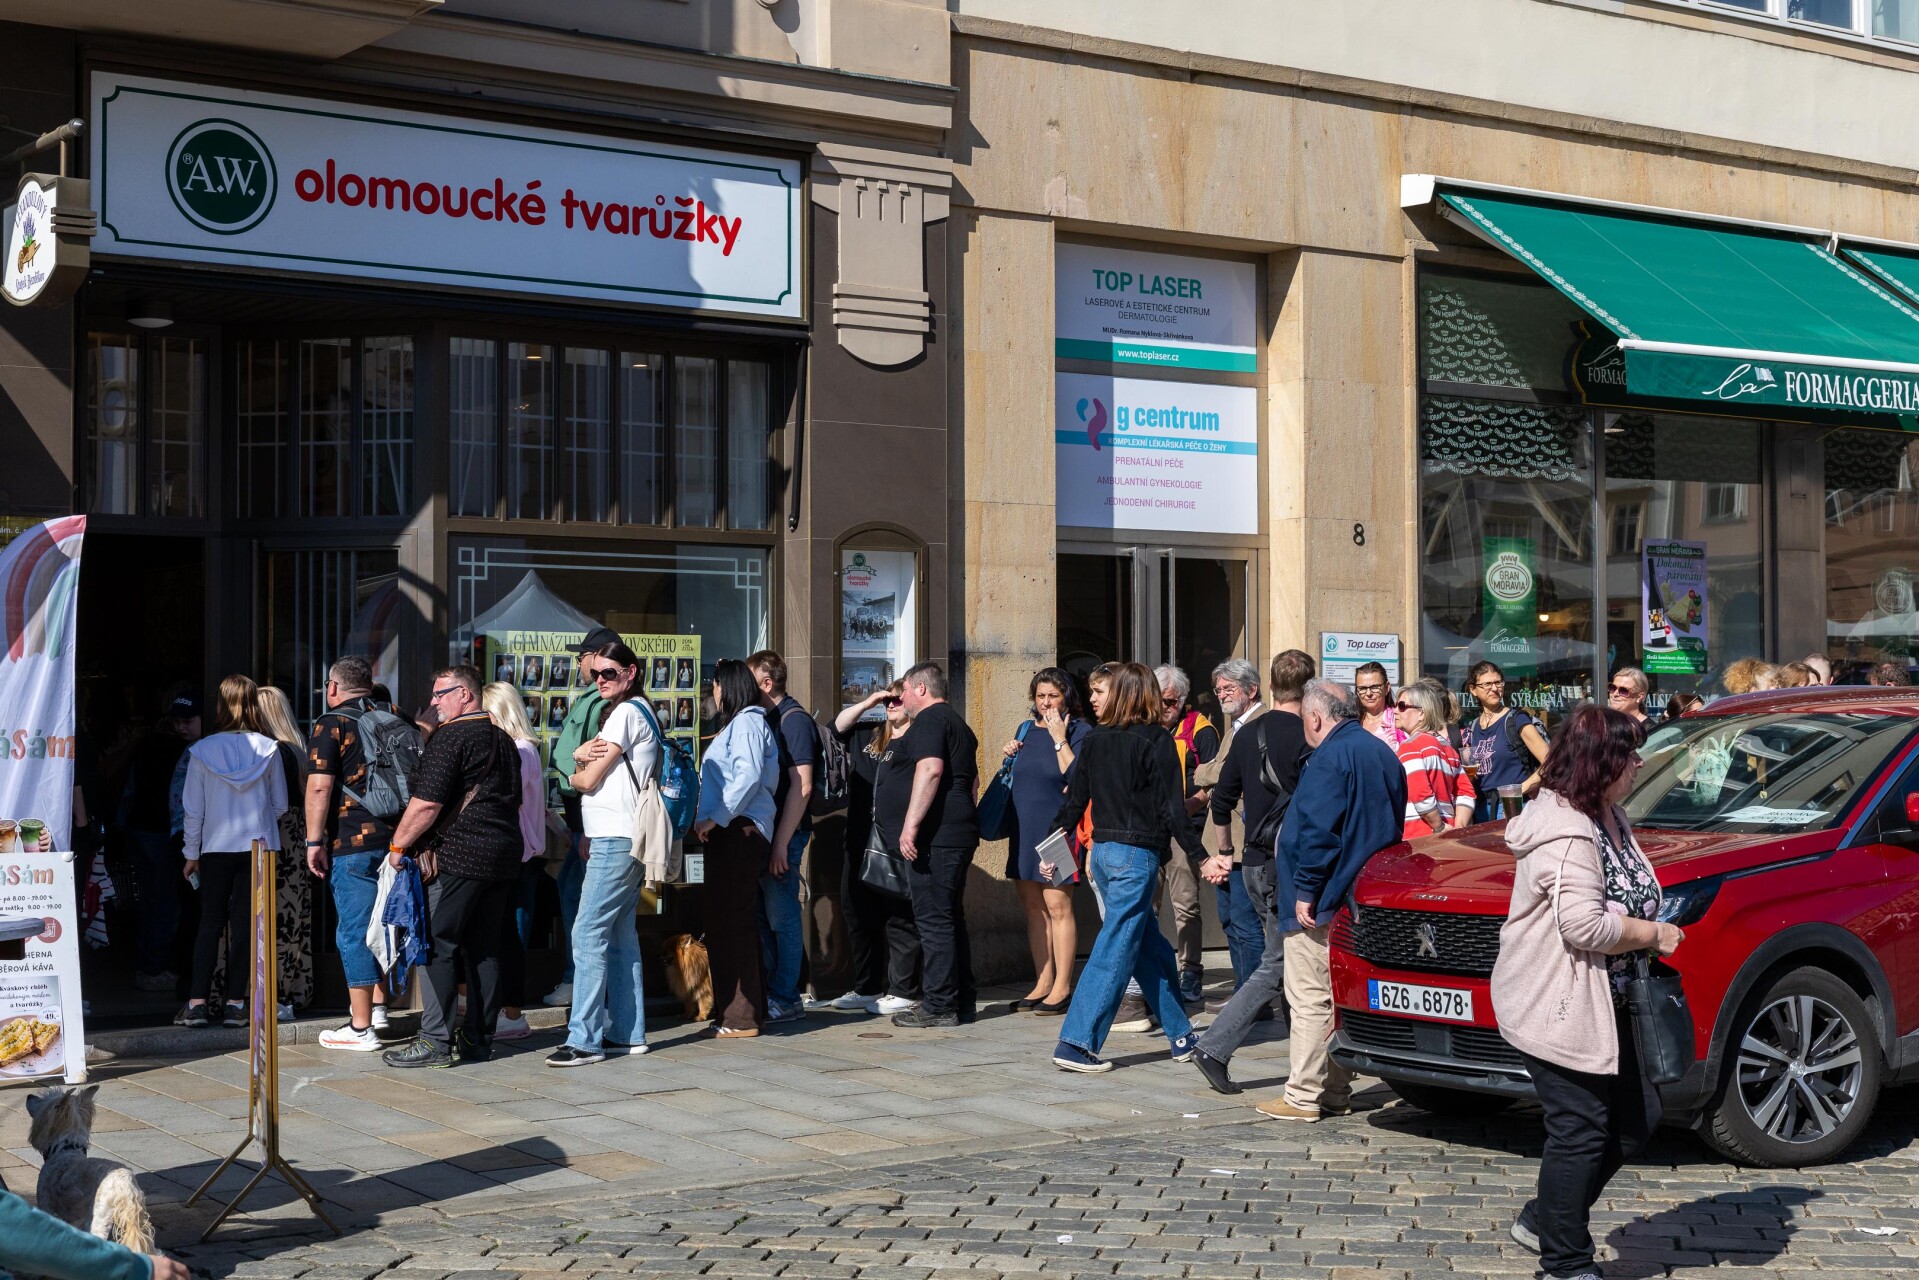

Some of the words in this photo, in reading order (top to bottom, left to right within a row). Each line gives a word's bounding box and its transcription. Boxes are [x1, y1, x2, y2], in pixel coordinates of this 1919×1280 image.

[295, 158, 546, 226] olomoucké
[561, 188, 742, 257] tvarůžky
[1092, 268, 1133, 292] TOP
[1139, 273, 1202, 299] LASER
[1084, 297, 1124, 309] LASEROVÉ
[1125, 301, 1132, 309] A
[1133, 301, 1173, 313] ESTETICKÉ
[1174, 305, 1210, 317] CENTRUM
[1118, 310, 1178, 324] DERMATOLOGIE
[1118, 349, 1180, 361] www.toplaser.cz
[1587, 367, 1627, 386] FORMAG
[1784, 370, 1919, 411] FORMAGGERIA
[1117, 405, 1129, 431] g
[1134, 405, 1220, 431] centrum
[1108, 436, 1148, 447] KOMPLEXNÍ
[1148, 438, 1184, 449] LÉKAŘSKÁ
[1185, 440, 1203, 450] PÉČE
[1203, 443, 1209, 451] O
[1209, 441, 1227, 452] ŽENY
[1115, 456, 1163, 468] PRENATÁLNÍ
[1164, 457, 1184, 468] PÉČE
[1096, 475, 1148, 487] AMBULANTNÍ
[1150, 478, 1202, 489] GYNEKOLOGIE
[1103, 497, 1153, 508] JEDNODENNÍ
[1154, 499, 1196, 510] CHIRURGIE
[1353, 523, 1365, 546] 8
[1499, 570, 1520, 580] GRAN
[1493, 580, 1526, 591] MORAVIA
[1347, 639, 1364, 650] Top
[1365, 640, 1389, 649] Laser
[32, 963, 54, 972] KÁVA
[1370, 998, 1379, 1006] CZ
[1381, 985, 1410, 1009] 6Z6
[1422, 990, 1464, 1016] 6878
